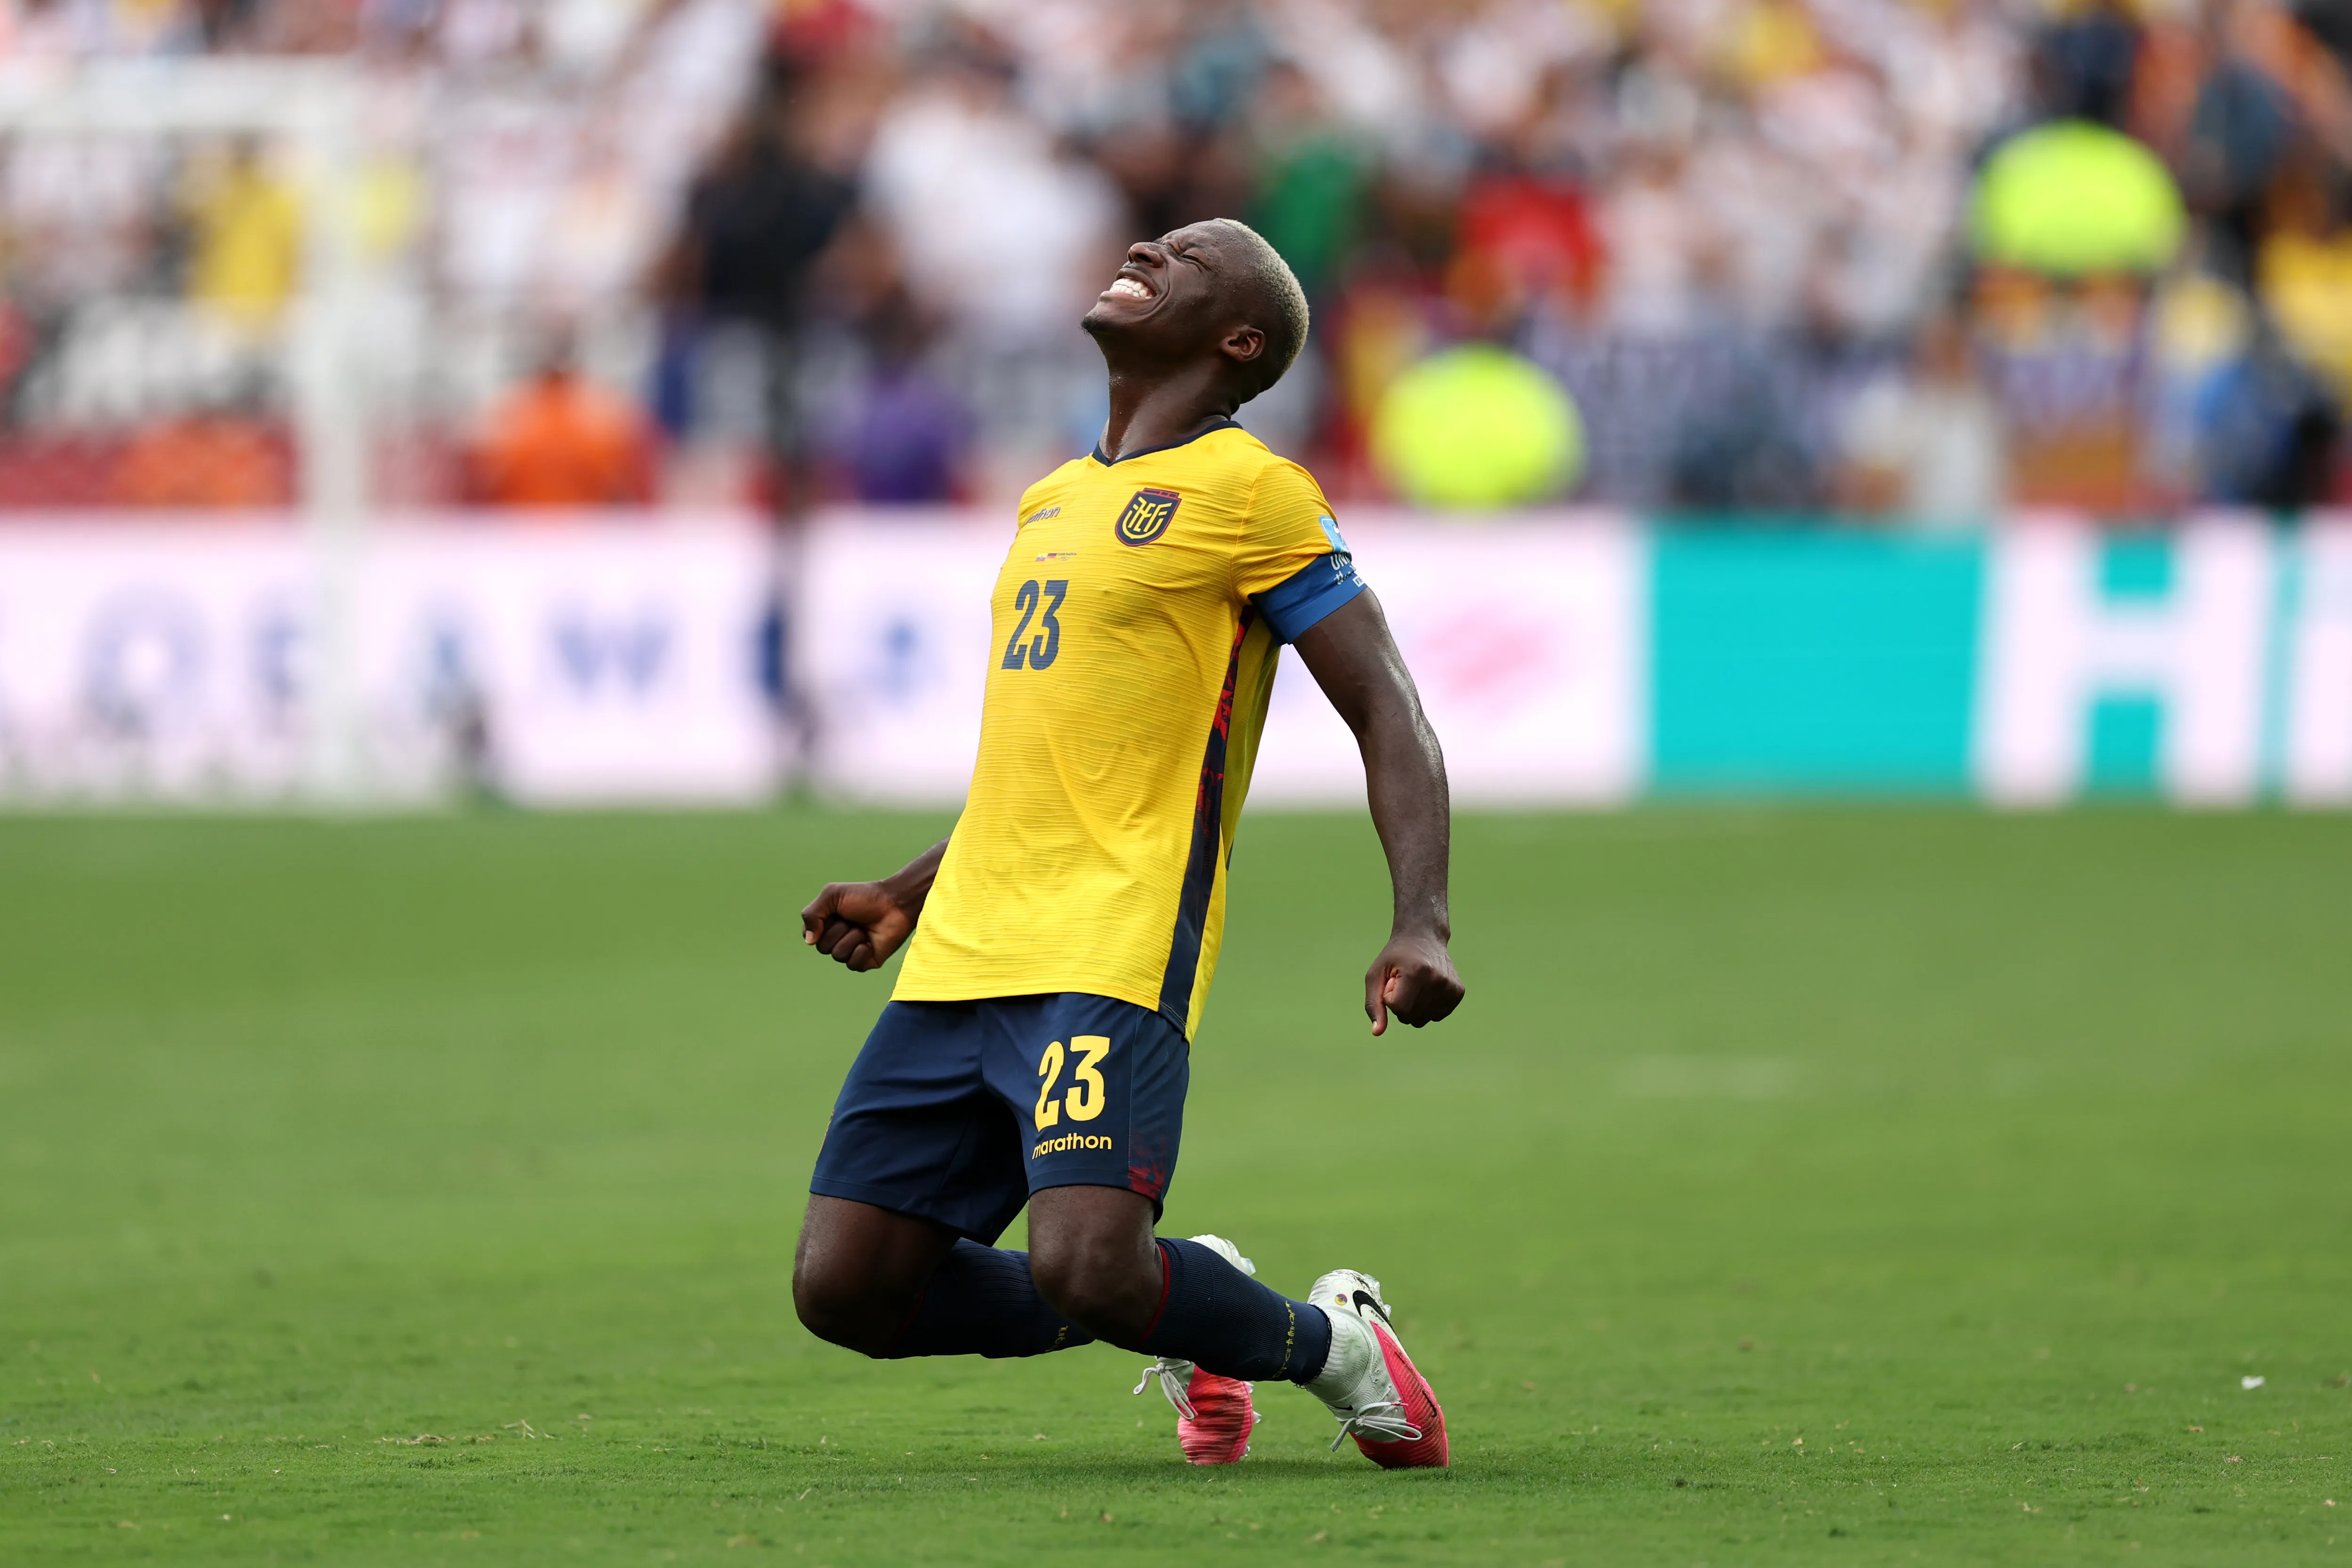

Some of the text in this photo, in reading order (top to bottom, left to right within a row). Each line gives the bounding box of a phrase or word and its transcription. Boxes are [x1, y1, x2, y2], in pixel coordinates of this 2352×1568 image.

[1002, 579, 1068, 671] 23
[1035, 1035, 1110, 1133] 23
[1032, 1133, 1112, 1159] marathon
